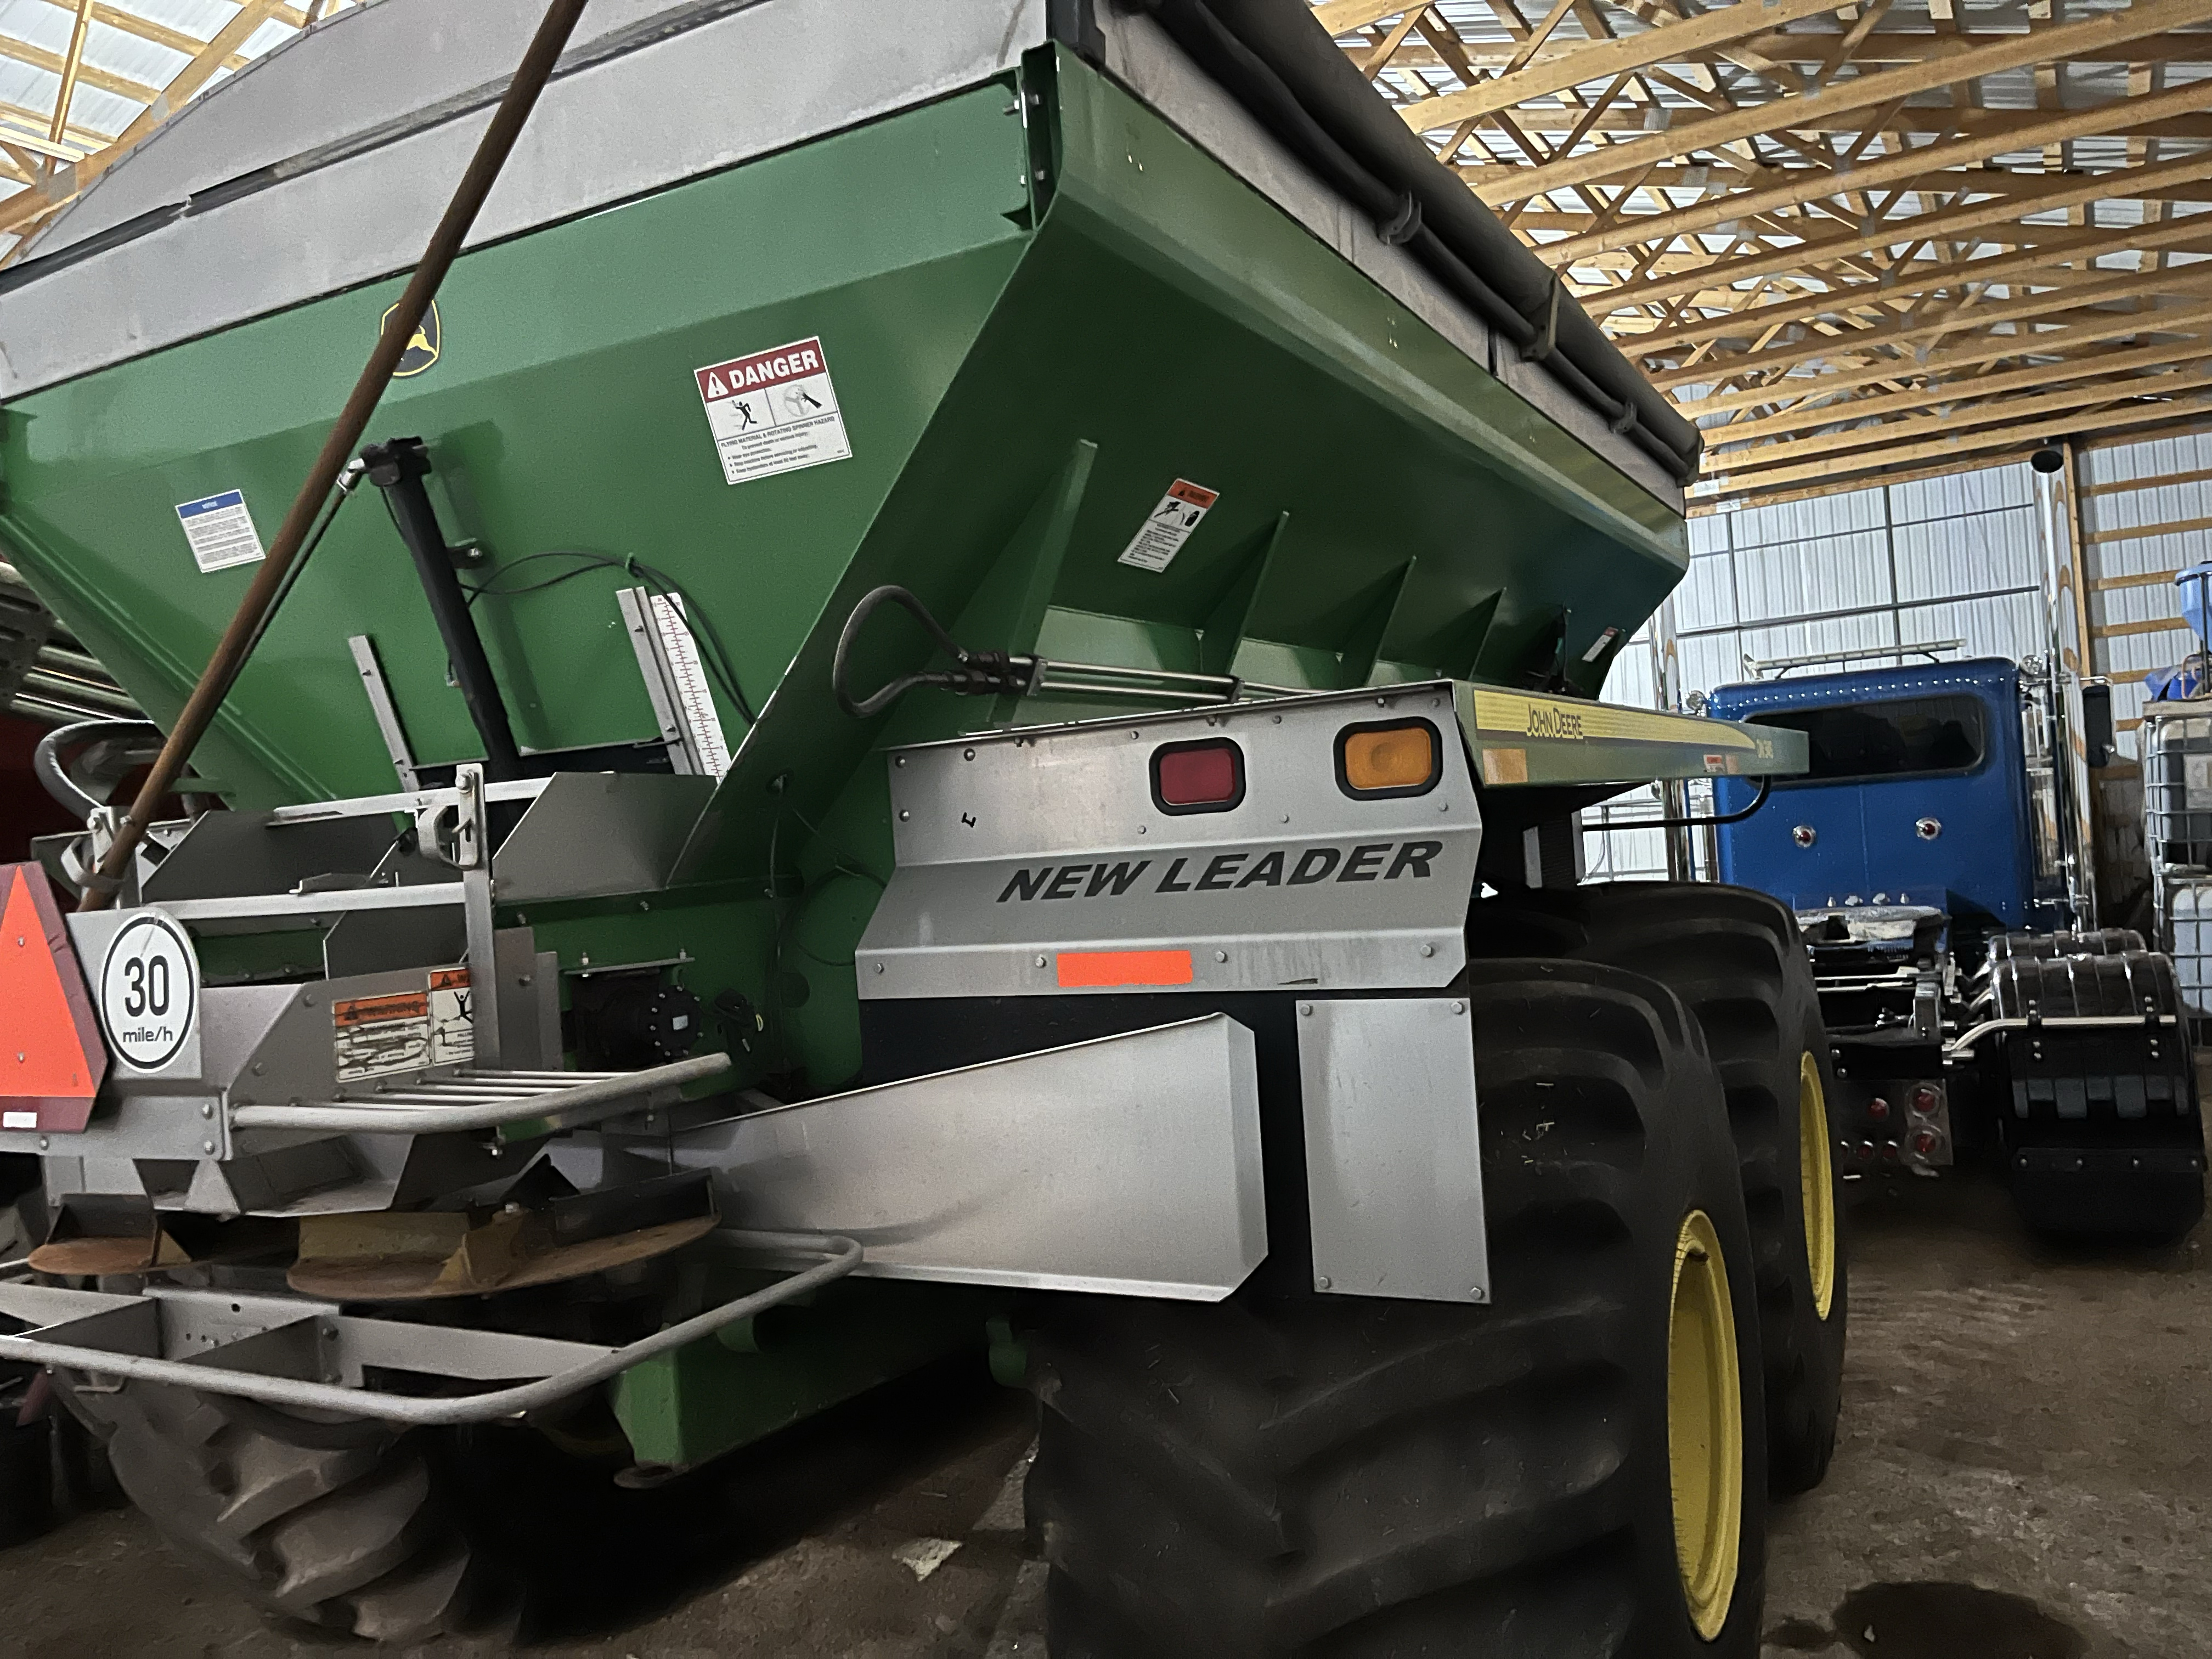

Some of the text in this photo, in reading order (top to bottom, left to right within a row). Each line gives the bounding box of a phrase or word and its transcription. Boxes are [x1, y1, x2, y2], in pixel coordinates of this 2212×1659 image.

[729, 349, 819, 389] DANGER
[738, 433, 762, 443] MATERIAL
[766, 426, 792, 437] ROTATING
[814, 416, 835, 425] HAZARD
[1527, 703, 1583, 736] JOHN DEERE
[996, 840, 1444, 904] NEW LEADER
[124, 955, 170, 1018] 30
[122, 1026, 173, 1043] mile/h
